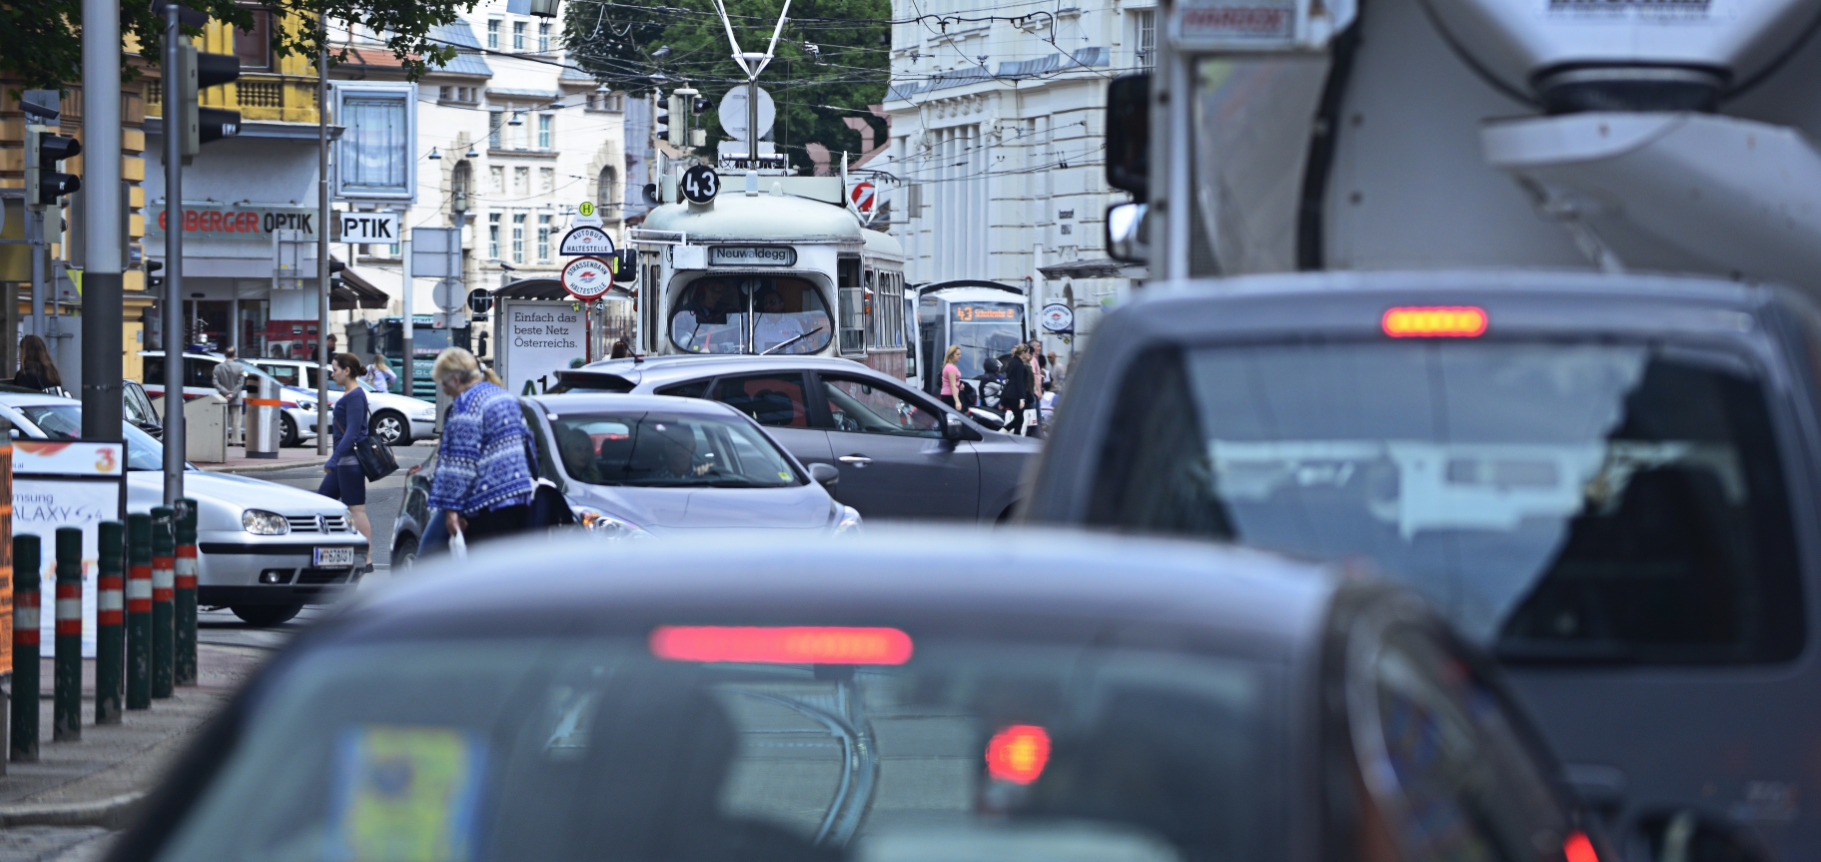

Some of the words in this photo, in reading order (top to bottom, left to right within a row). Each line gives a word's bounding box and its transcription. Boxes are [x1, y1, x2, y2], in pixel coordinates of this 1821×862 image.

[686, 171, 716, 197] 43
[583, 206, 591, 214] H
[158, 210, 259, 233] EBERGER
[263, 213, 313, 234] OPTIK
[340, 217, 391, 238] PTIK
[573, 230, 603, 241] AUTOBUS
[716, 248, 786, 261] Neuwaldegg
[567, 261, 608, 276] STRASSENBAHN
[570, 282, 607, 295] HALTESTELLE
[514, 311, 554, 323] Einfach
[557, 311, 577, 323] das
[957, 307, 973, 321] 43
[514, 325, 542, 335] beste
[545, 325, 569, 335] Netz
[514, 336, 577, 348] Österreichs.
[95, 447, 115, 473] 3
[12, 493, 54, 505] msung
[12, 505, 71, 521] ALAXY
